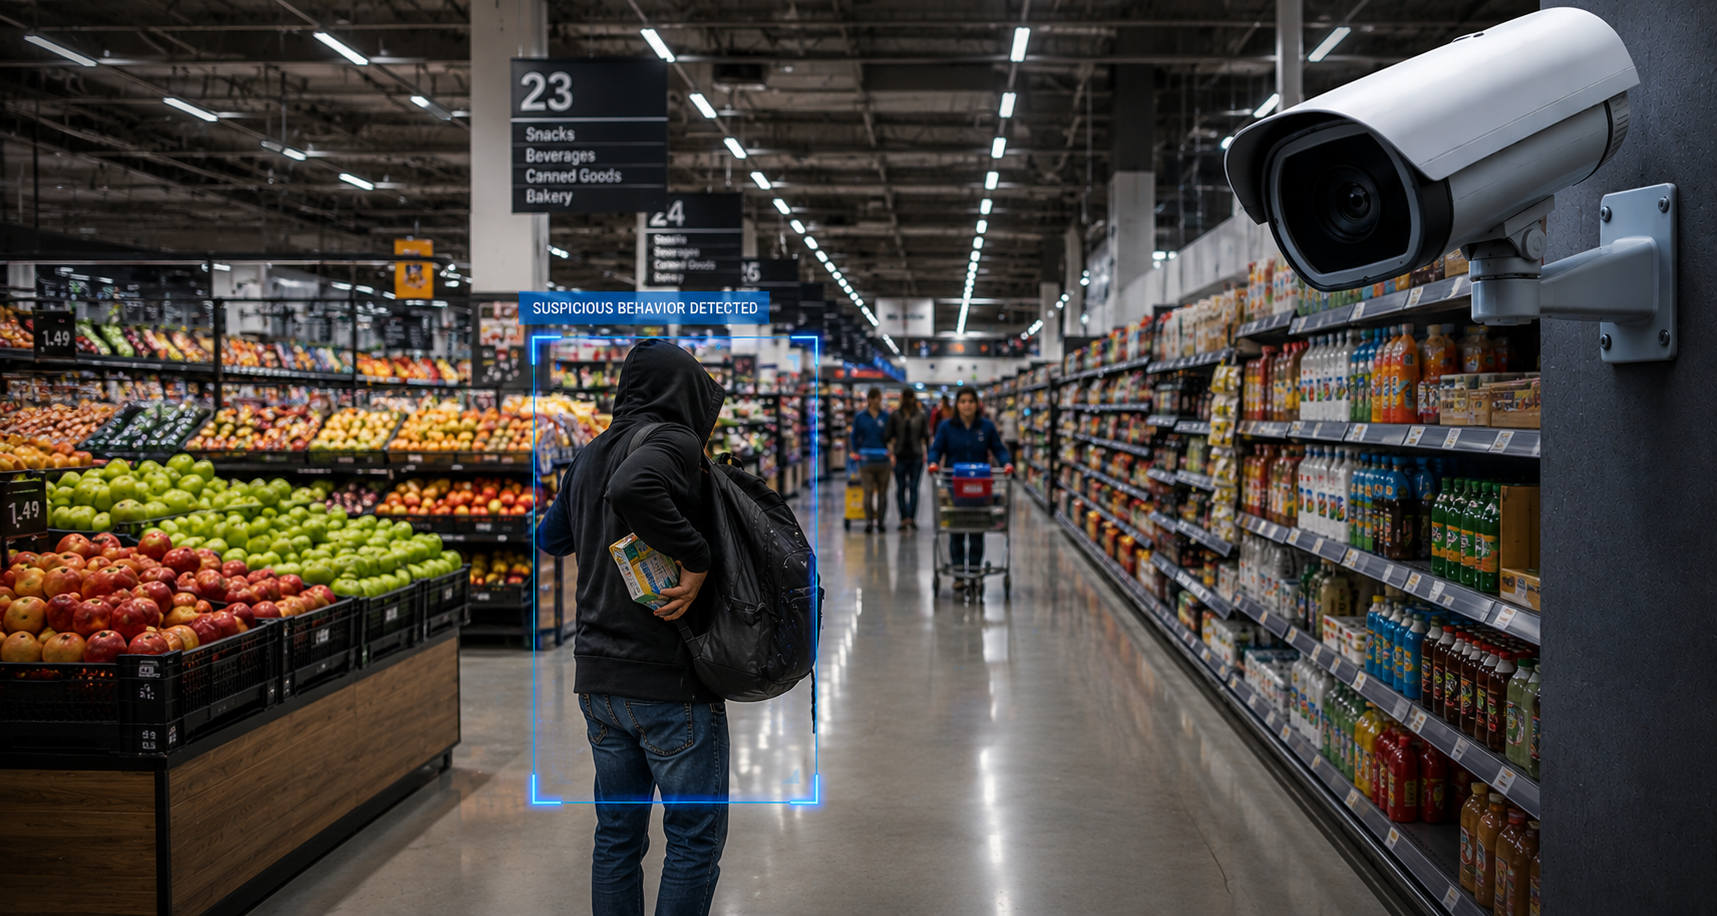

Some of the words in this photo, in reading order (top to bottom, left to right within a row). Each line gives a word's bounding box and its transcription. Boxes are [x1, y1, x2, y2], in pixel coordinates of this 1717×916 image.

[520, 71, 574, 112] 23
[525, 126, 576, 142] Snacks
[525, 148, 596, 166] Beverages
[525, 168, 577, 184] Canned
[579, 167, 622, 183] Goods
[525, 188, 573, 207] Bakery
[42, 330, 71, 346] 1.49
[8, 500, 40, 525] 1.49
